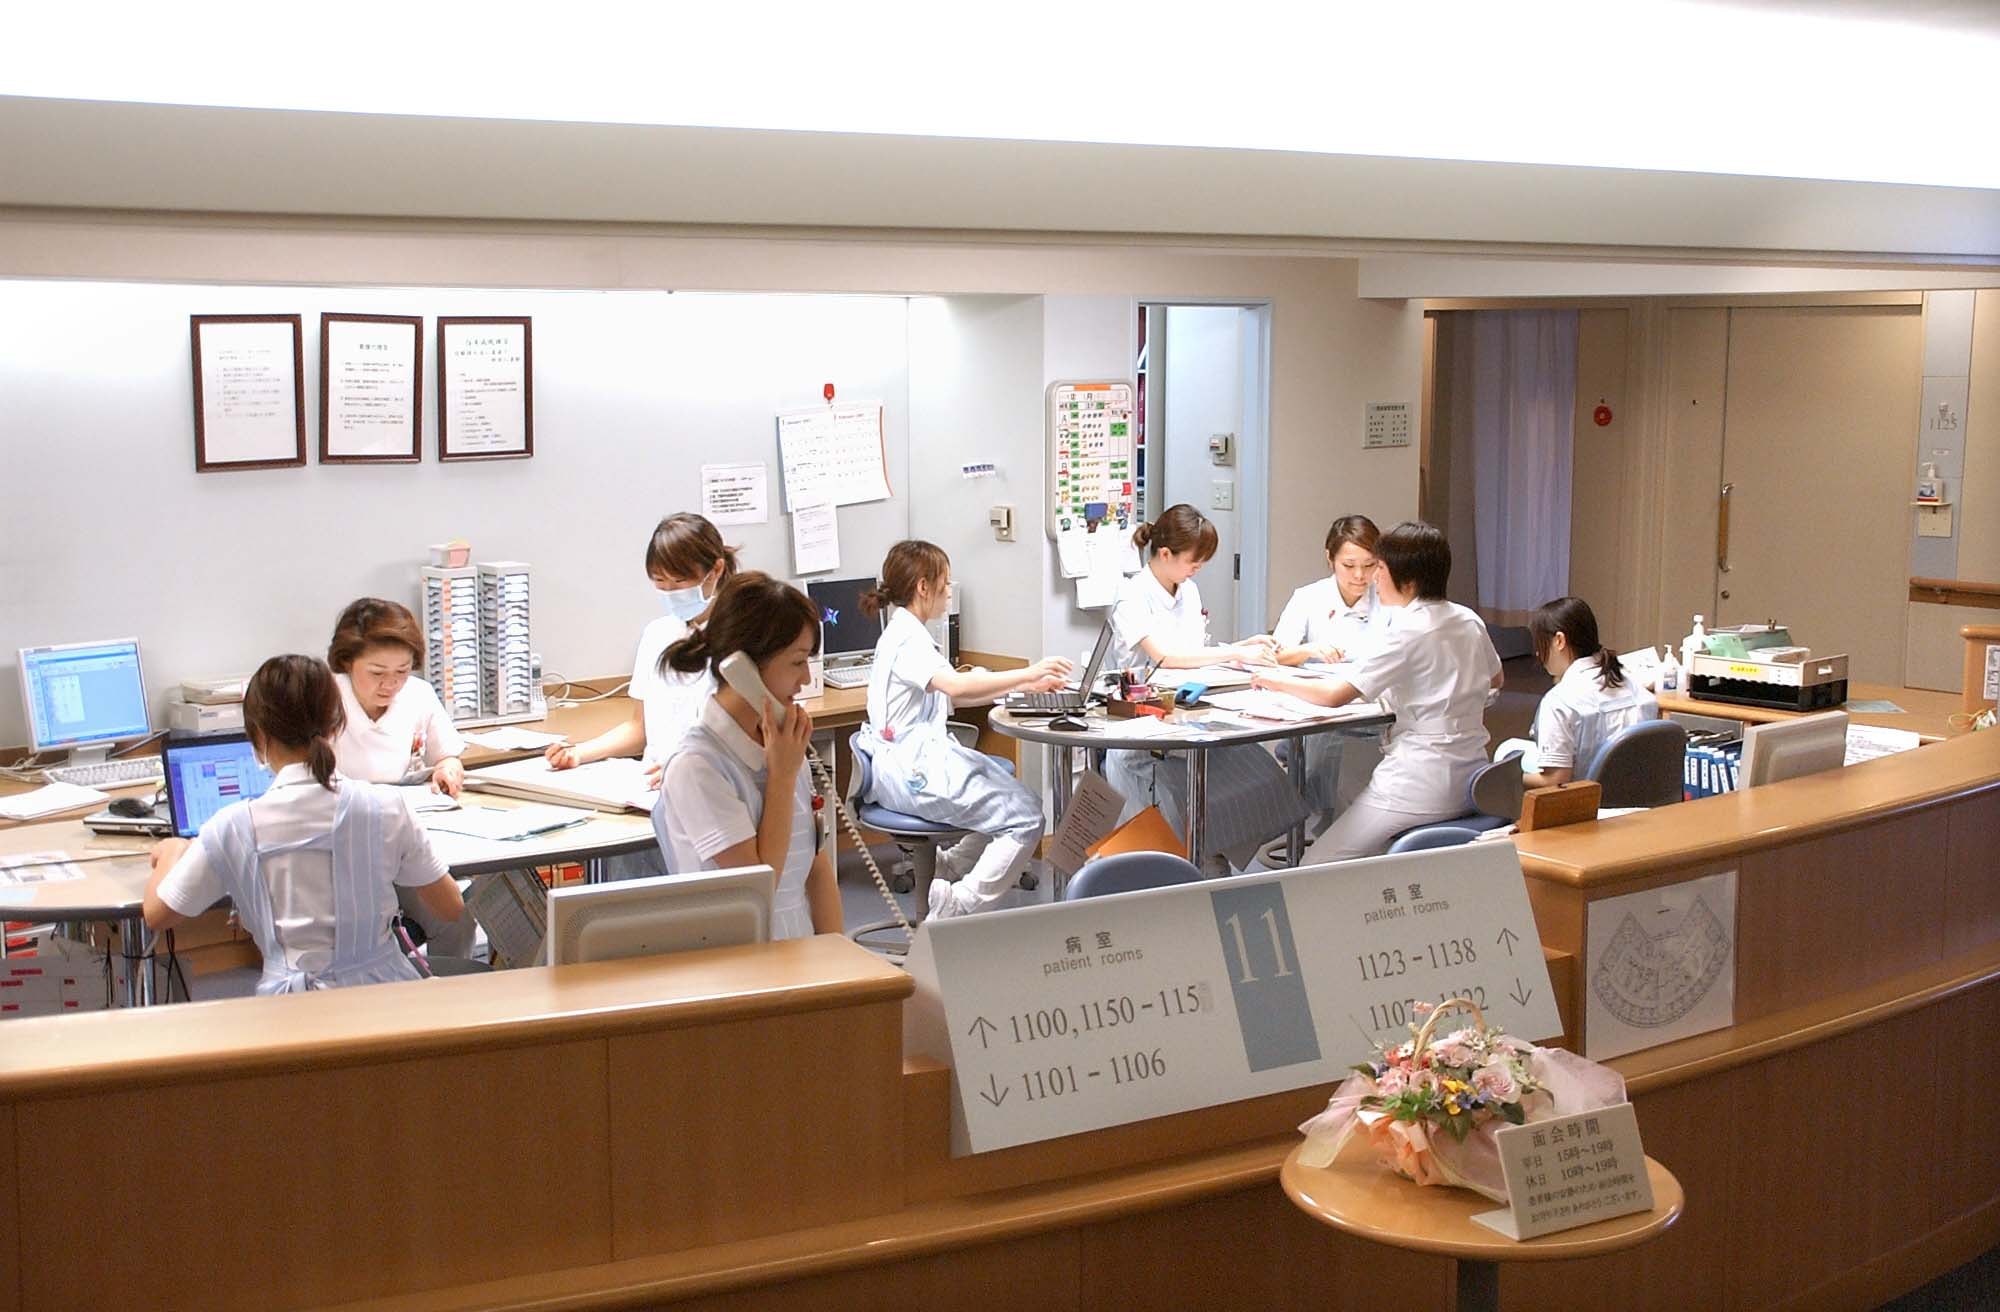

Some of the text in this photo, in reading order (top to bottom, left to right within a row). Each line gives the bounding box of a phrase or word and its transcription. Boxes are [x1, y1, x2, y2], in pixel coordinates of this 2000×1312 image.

[1929, 413, 1958, 431] 1125
[1364, 900, 1449, 925] patient rooms
[1225, 907, 1294, 983] 11
[1043, 949, 1144, 977] patient rooms
[1532, 1118, 1600, 1148] 面会時間
